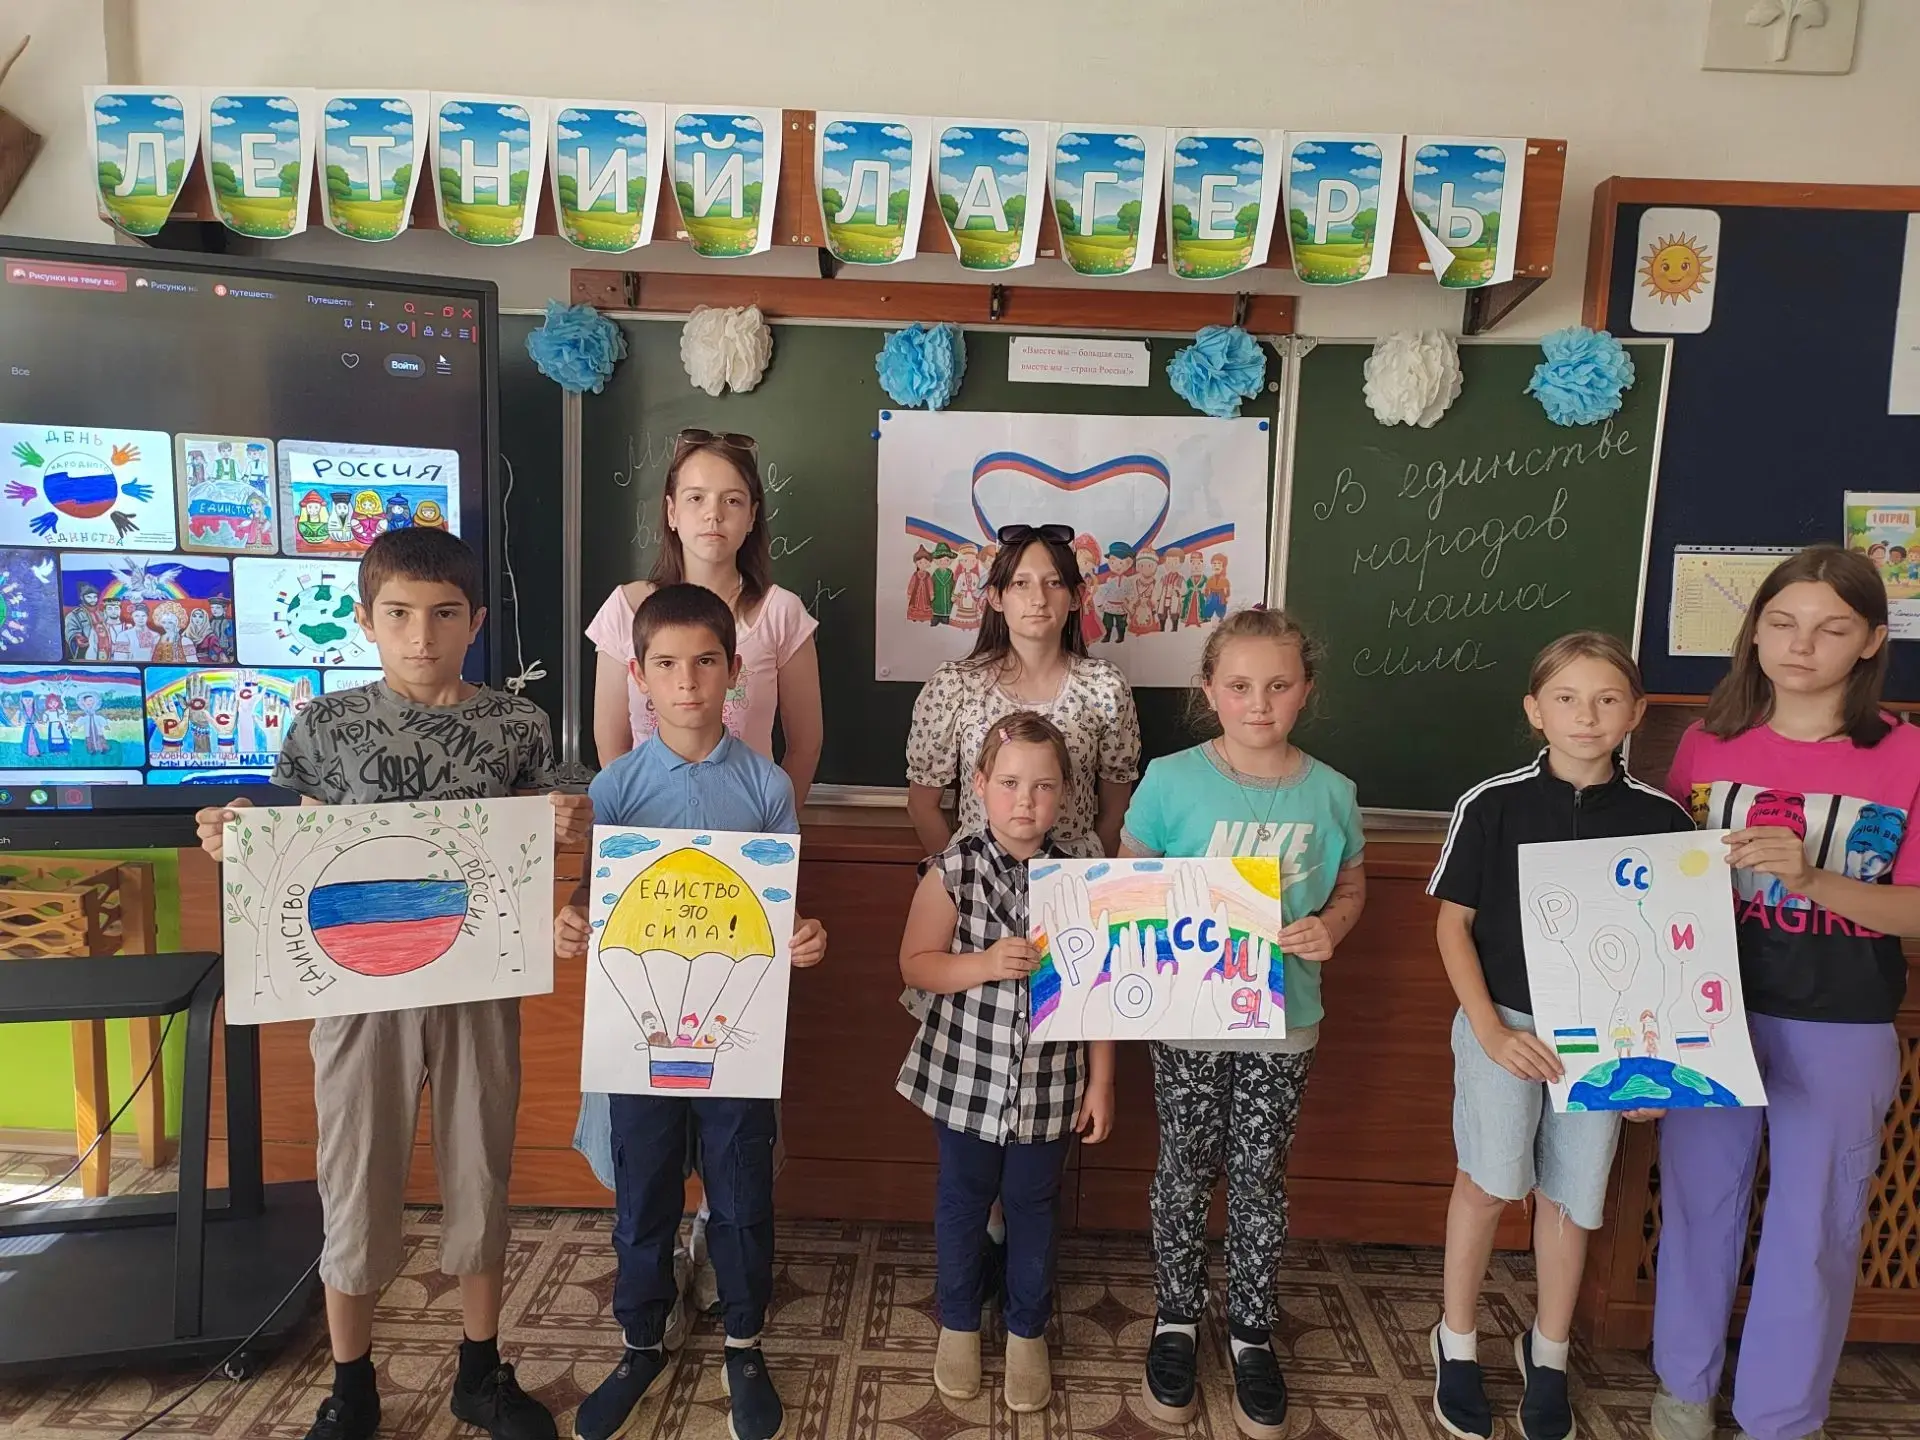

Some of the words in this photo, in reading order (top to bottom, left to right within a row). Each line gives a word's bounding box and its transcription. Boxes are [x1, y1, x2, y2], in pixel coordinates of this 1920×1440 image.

[114, 131, 746, 219] ЛЕТНИЙ
[834, 159, 1484, 249] ЛАГЕРЬ
[29, 271, 66, 283] Рисунки
[81, 277, 101, 286] тему
[151, 281, 187, 292] Рисунки
[1078, 348, 1112, 358] большая
[11, 366, 31, 376] Все
[391, 359, 419, 371] Войти
[1021, 363, 1048, 371] вместе
[1071, 367, 1097, 375] страна
[45, 430, 103, 446] ДЕНЬ
[312, 458, 443, 482] РОССИЯ
[1313, 467, 1367, 521] В
[1397, 418, 1638, 521] единстве
[1872, 512, 1878, 524] 1
[1878, 512, 1910, 525] ОТРЯД
[45, 532, 124, 546] ЕДИНСТВА
[1352, 487, 1569, 592] народов
[1387, 583, 1572, 629] наша
[1352, 639, 1498, 677] сила
[149, 752, 188, 760] СЛОВНО
[1204, 820, 1305, 875] NIKE
[461, 858, 489, 938] РОССИИ
[640, 879, 740, 900] ЕДИСТВО
[677, 904, 708, 921] ЭТО
[1732, 887, 1885, 938] AGIR
[280, 883, 337, 997] ЕДИНСТВО
